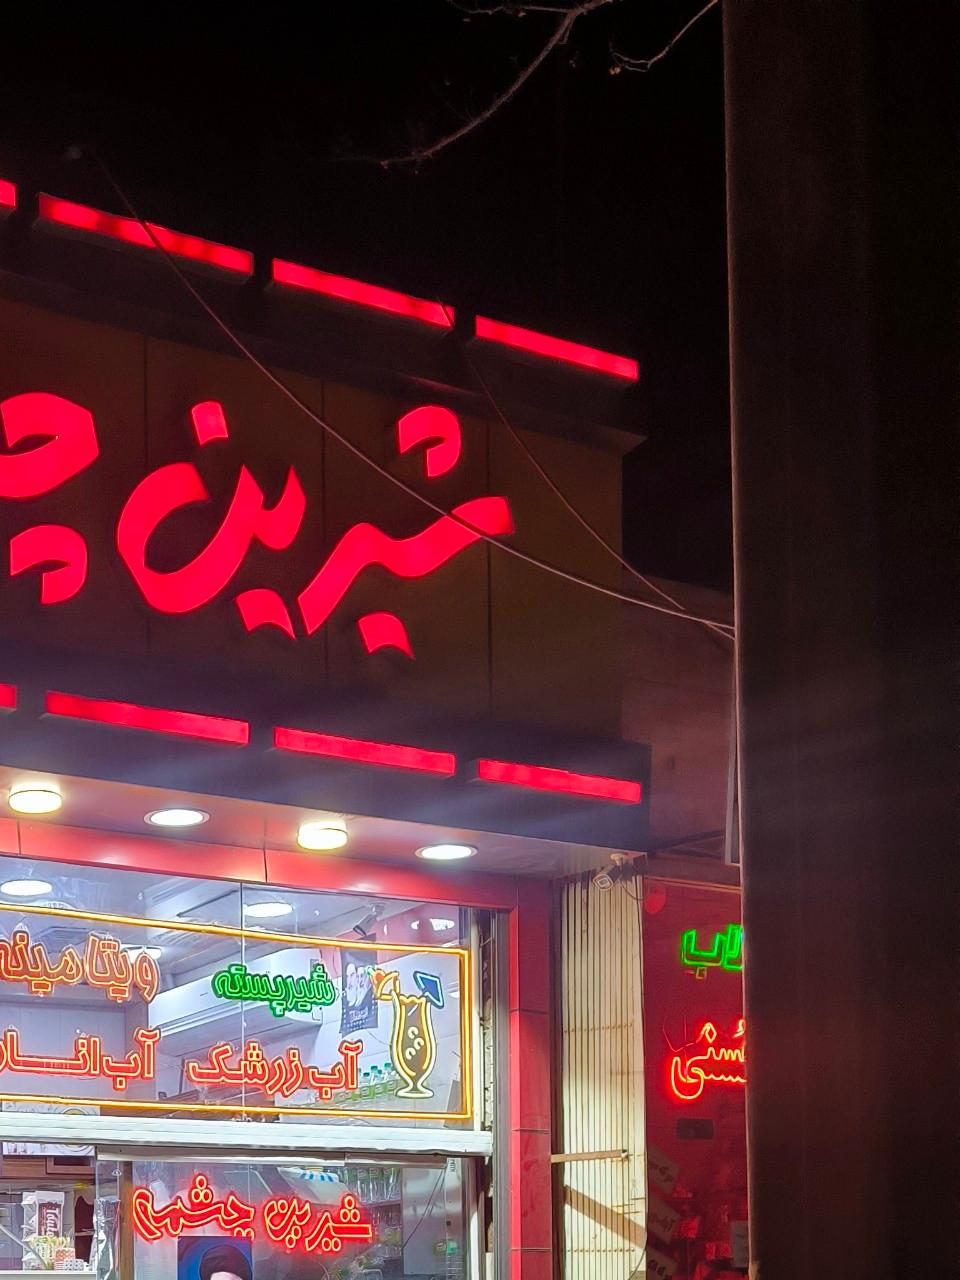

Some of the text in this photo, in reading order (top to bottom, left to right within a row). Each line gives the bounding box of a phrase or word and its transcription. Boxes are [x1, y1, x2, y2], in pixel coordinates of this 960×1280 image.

[117, 401, 515, 660] شیرین
[102, 1029, 160, 1090] آب
[188, 1041, 363, 1100] آب زرشک
[132, 1172, 373, 1253] شیرین چشمه
